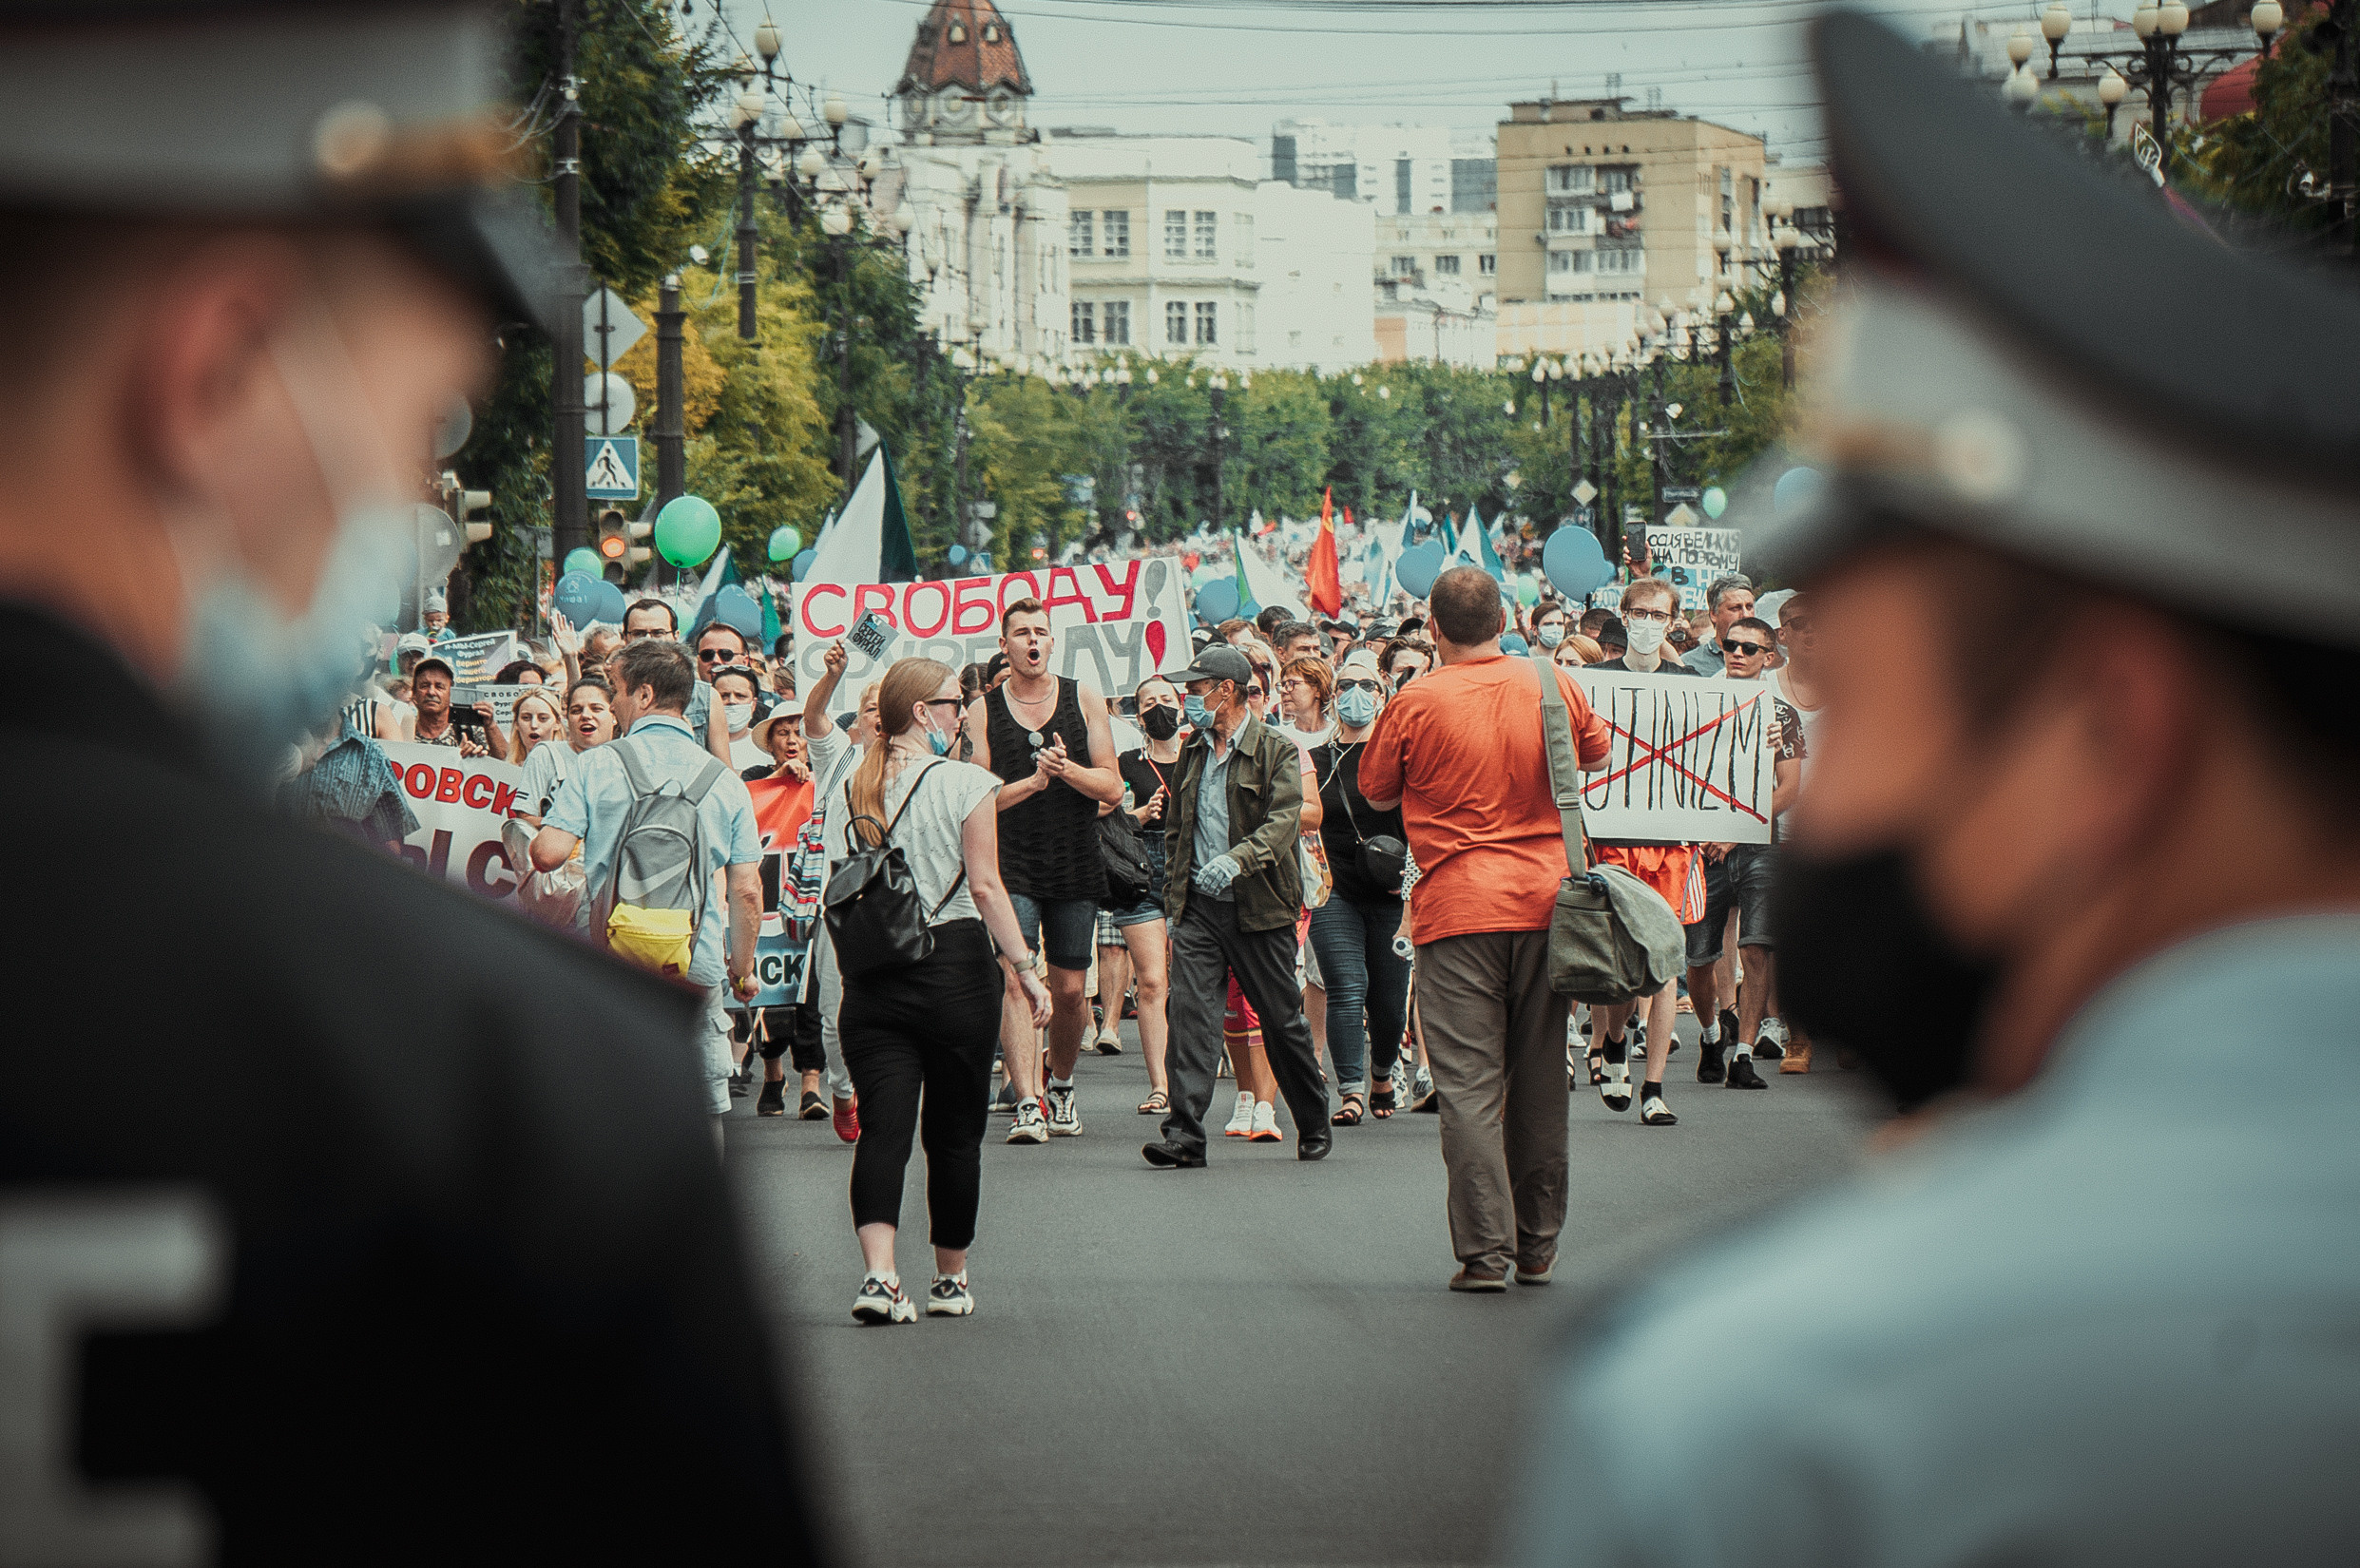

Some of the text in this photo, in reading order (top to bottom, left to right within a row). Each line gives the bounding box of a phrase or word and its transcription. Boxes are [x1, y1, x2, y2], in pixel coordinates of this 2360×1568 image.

[1679, 548, 1738, 572] ПОЭТОМУ
[852, 632, 881, 658] ФУРГАЛ
[858, 621, 887, 648] СЕРГЕЙ
[455, 675, 496, 684] бернатора
[1584, 685, 1762, 813] UTINIZM
[754, 953, 808, 986] СК
